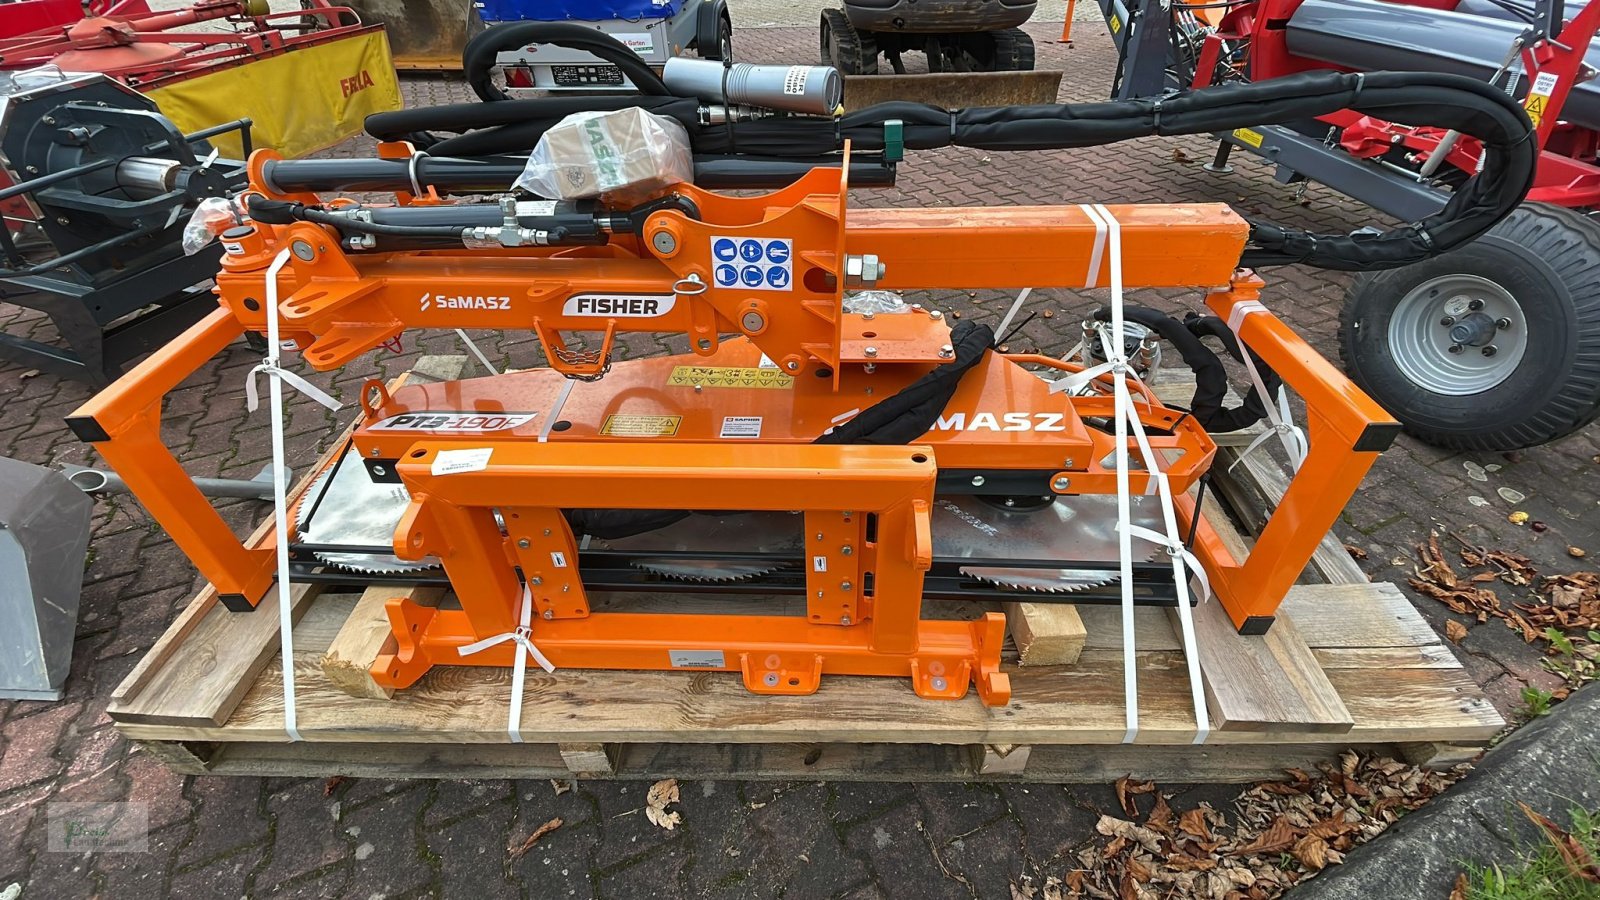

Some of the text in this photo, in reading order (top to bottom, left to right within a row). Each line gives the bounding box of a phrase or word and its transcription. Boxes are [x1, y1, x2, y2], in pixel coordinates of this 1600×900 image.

[435, 295, 511, 310] SaMASZ
[577, 298, 659, 315] FISHER
[386, 415, 523, 430] PT3-190F
[929, 412, 1066, 432] MASZ
